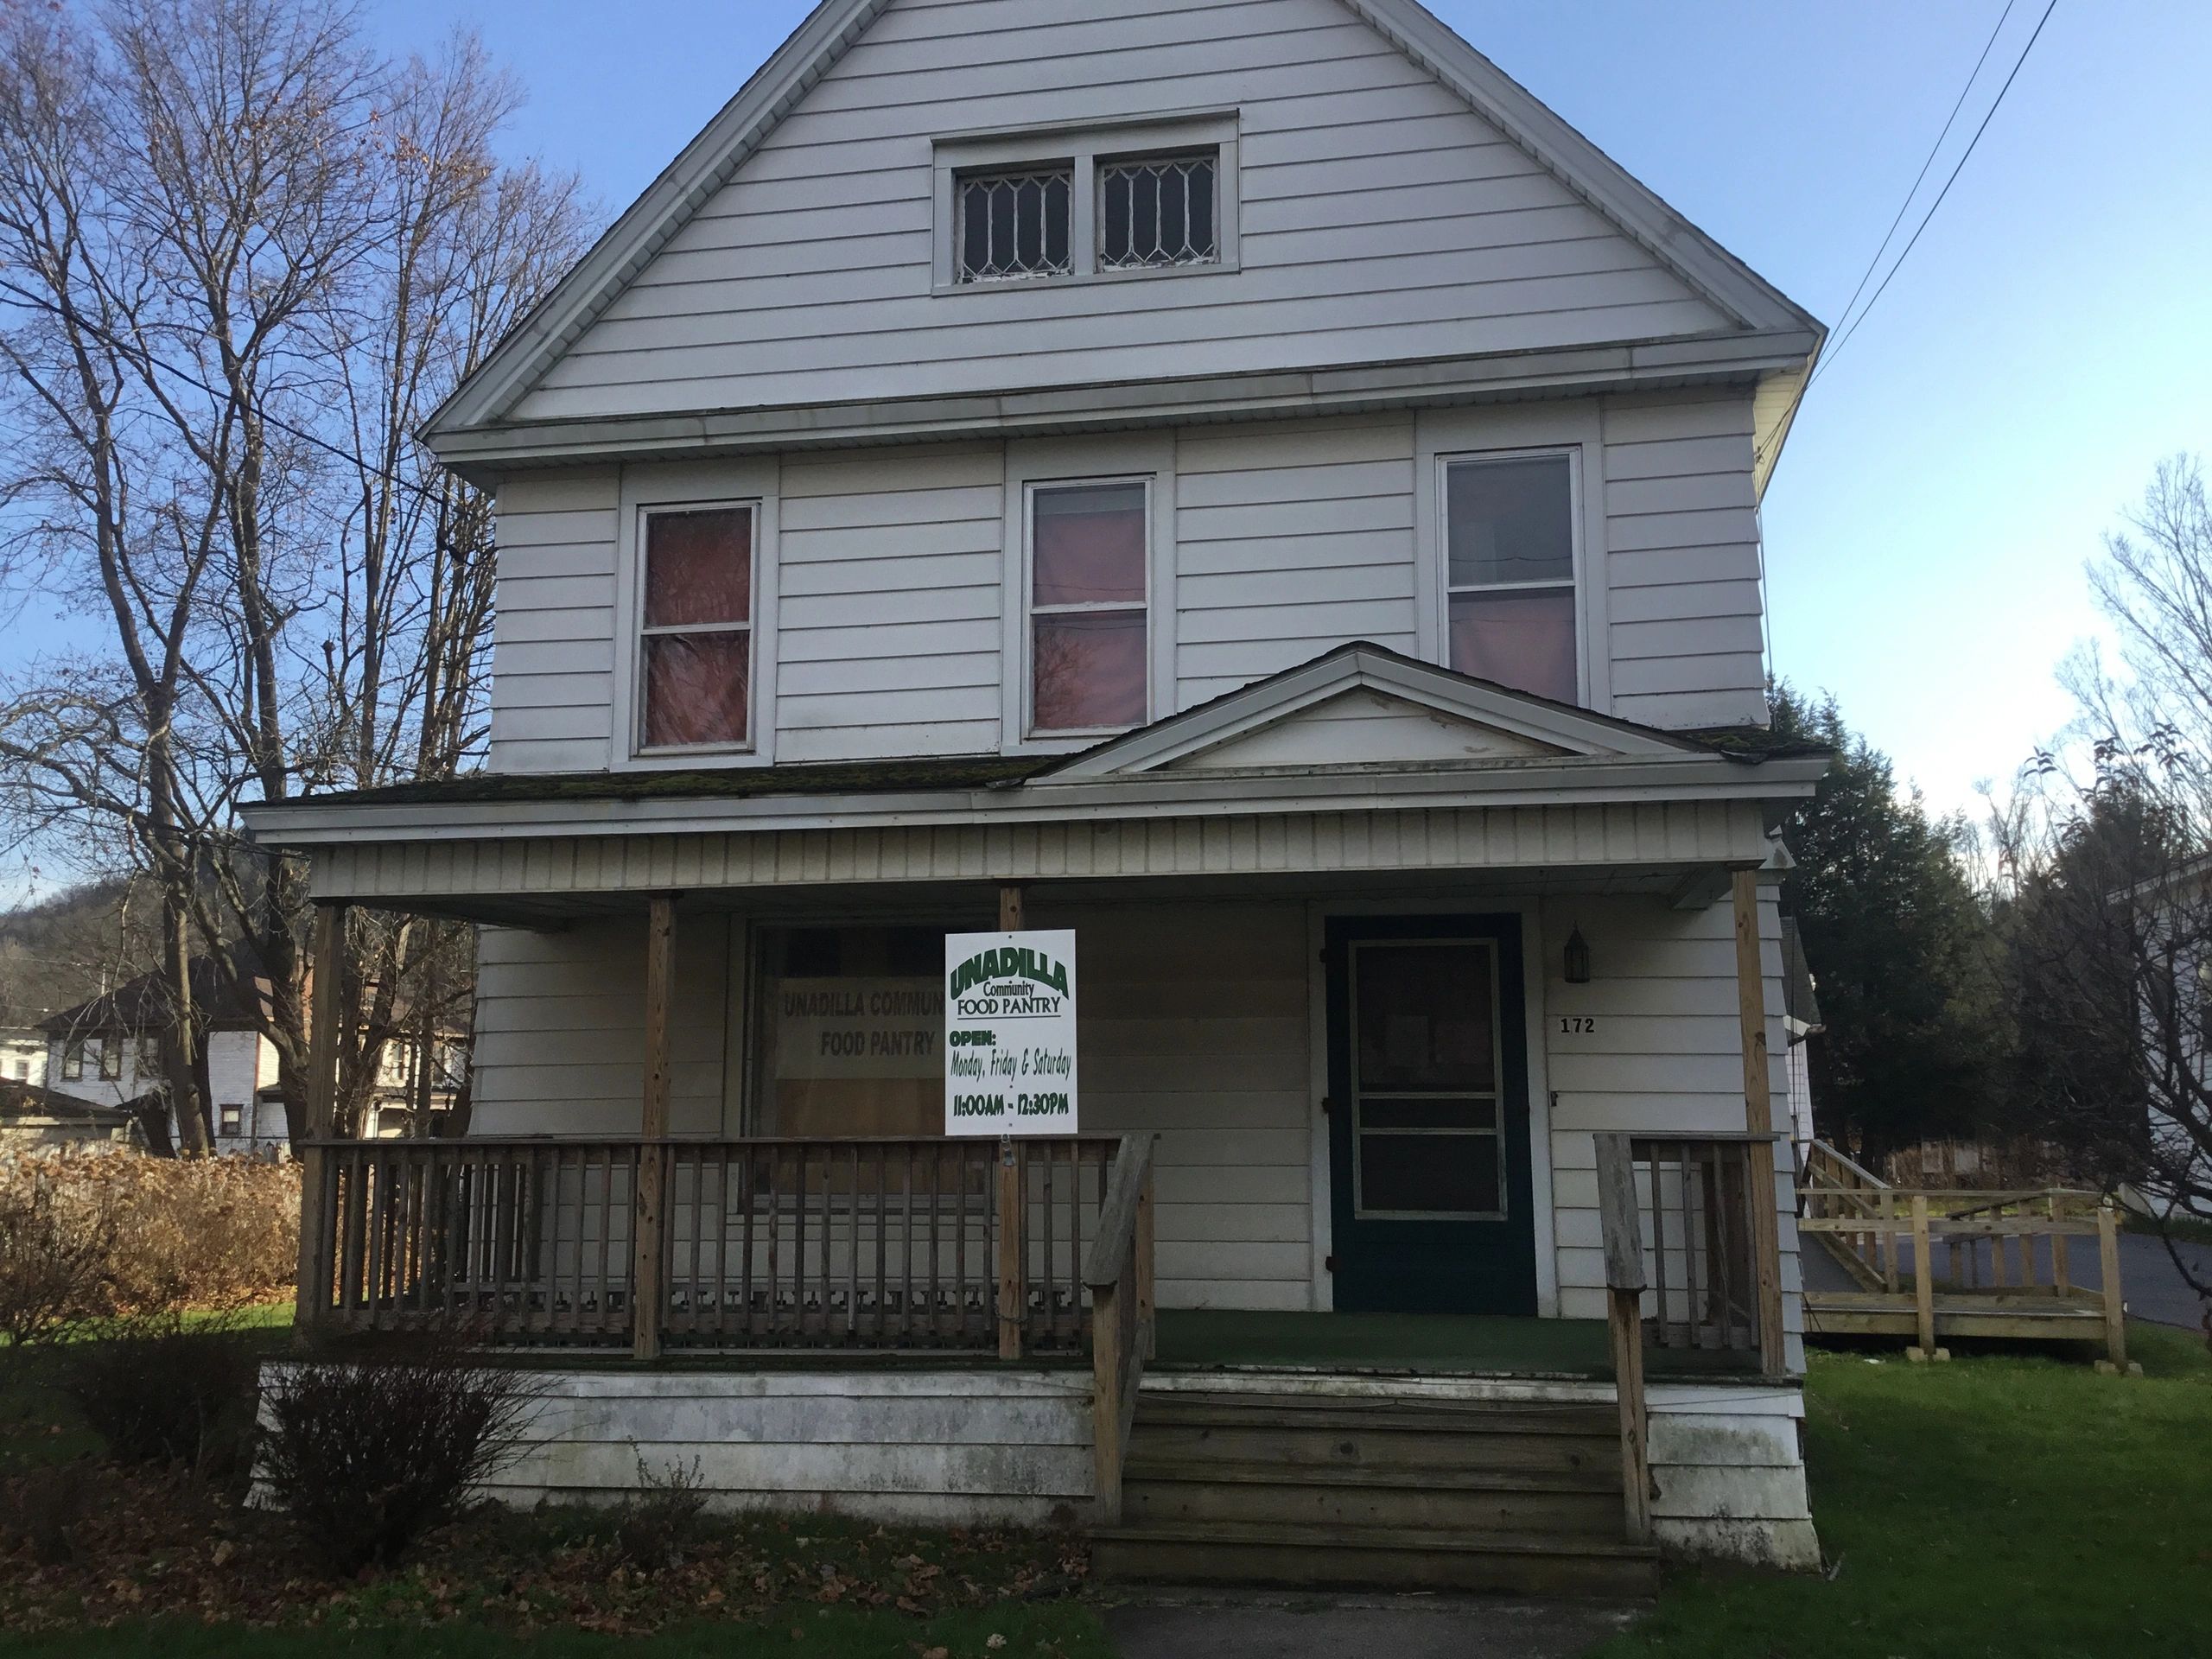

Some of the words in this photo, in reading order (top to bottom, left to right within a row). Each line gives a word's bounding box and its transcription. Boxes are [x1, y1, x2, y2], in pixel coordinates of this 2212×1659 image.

[950, 947, 1070, 1001] UNADILLA
[983, 981, 1035, 998] Community
[785, 991, 865, 1017] UNADILLA
[957, 999, 998, 1015] FOOD
[1003, 997, 1061, 1014] PANTRY
[1560, 1018, 1595, 1033] 172
[821, 1031, 865, 1057] FOOD
[870, 1031, 936, 1056] PANTRY
[950, 1030, 996, 1047] OPEN:
[950, 1050, 985, 1083] Monday,
[990, 1048, 1017, 1082] Friday
[1021, 1047, 1029, 1076] &
[1033, 1047, 1071, 1081] Saturday
[953, 1094, 1004, 1116] 11:00AM
[1017, 1092, 1069, 1116] 12:30PM
